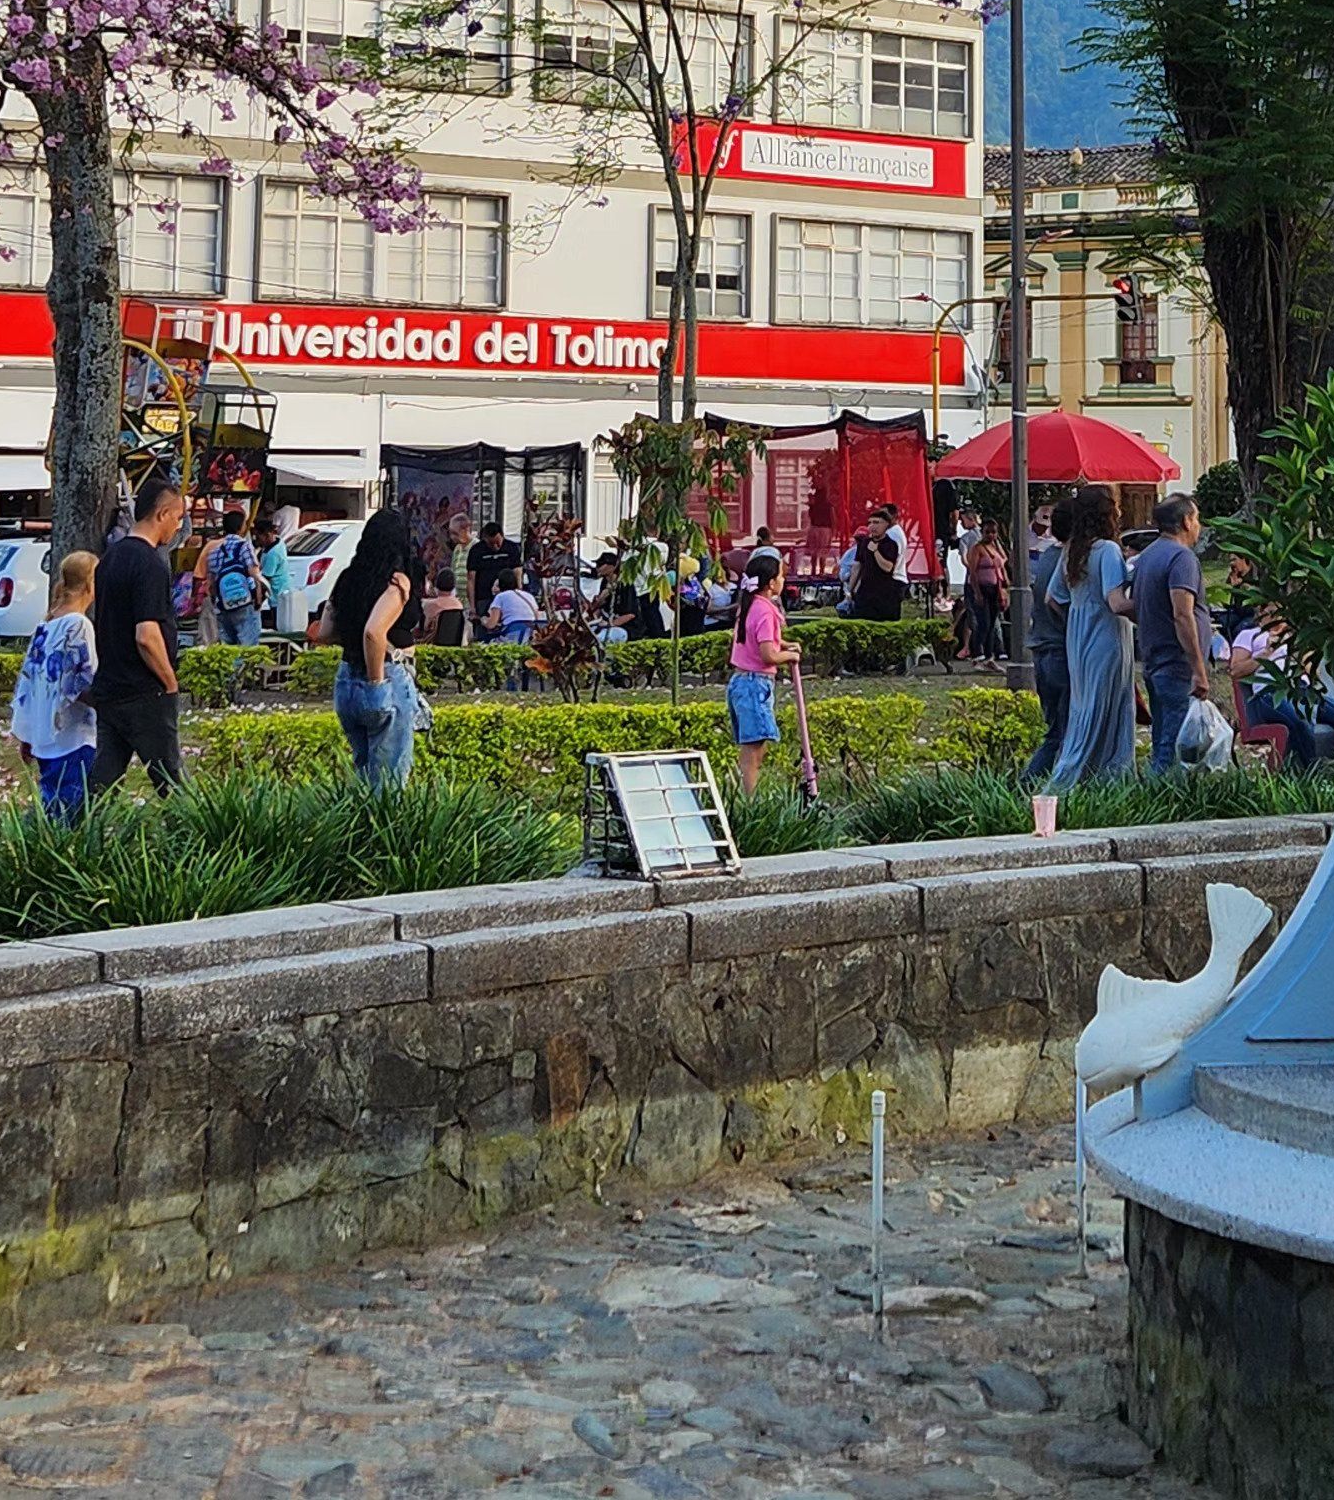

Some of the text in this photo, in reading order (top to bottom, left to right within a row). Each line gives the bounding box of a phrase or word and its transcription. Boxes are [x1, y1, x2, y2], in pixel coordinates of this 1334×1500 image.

[749, 137, 930, 181] AllianceFrançaise
[214, 311, 462, 362] Universidad
[475, 321, 538, 364] del
